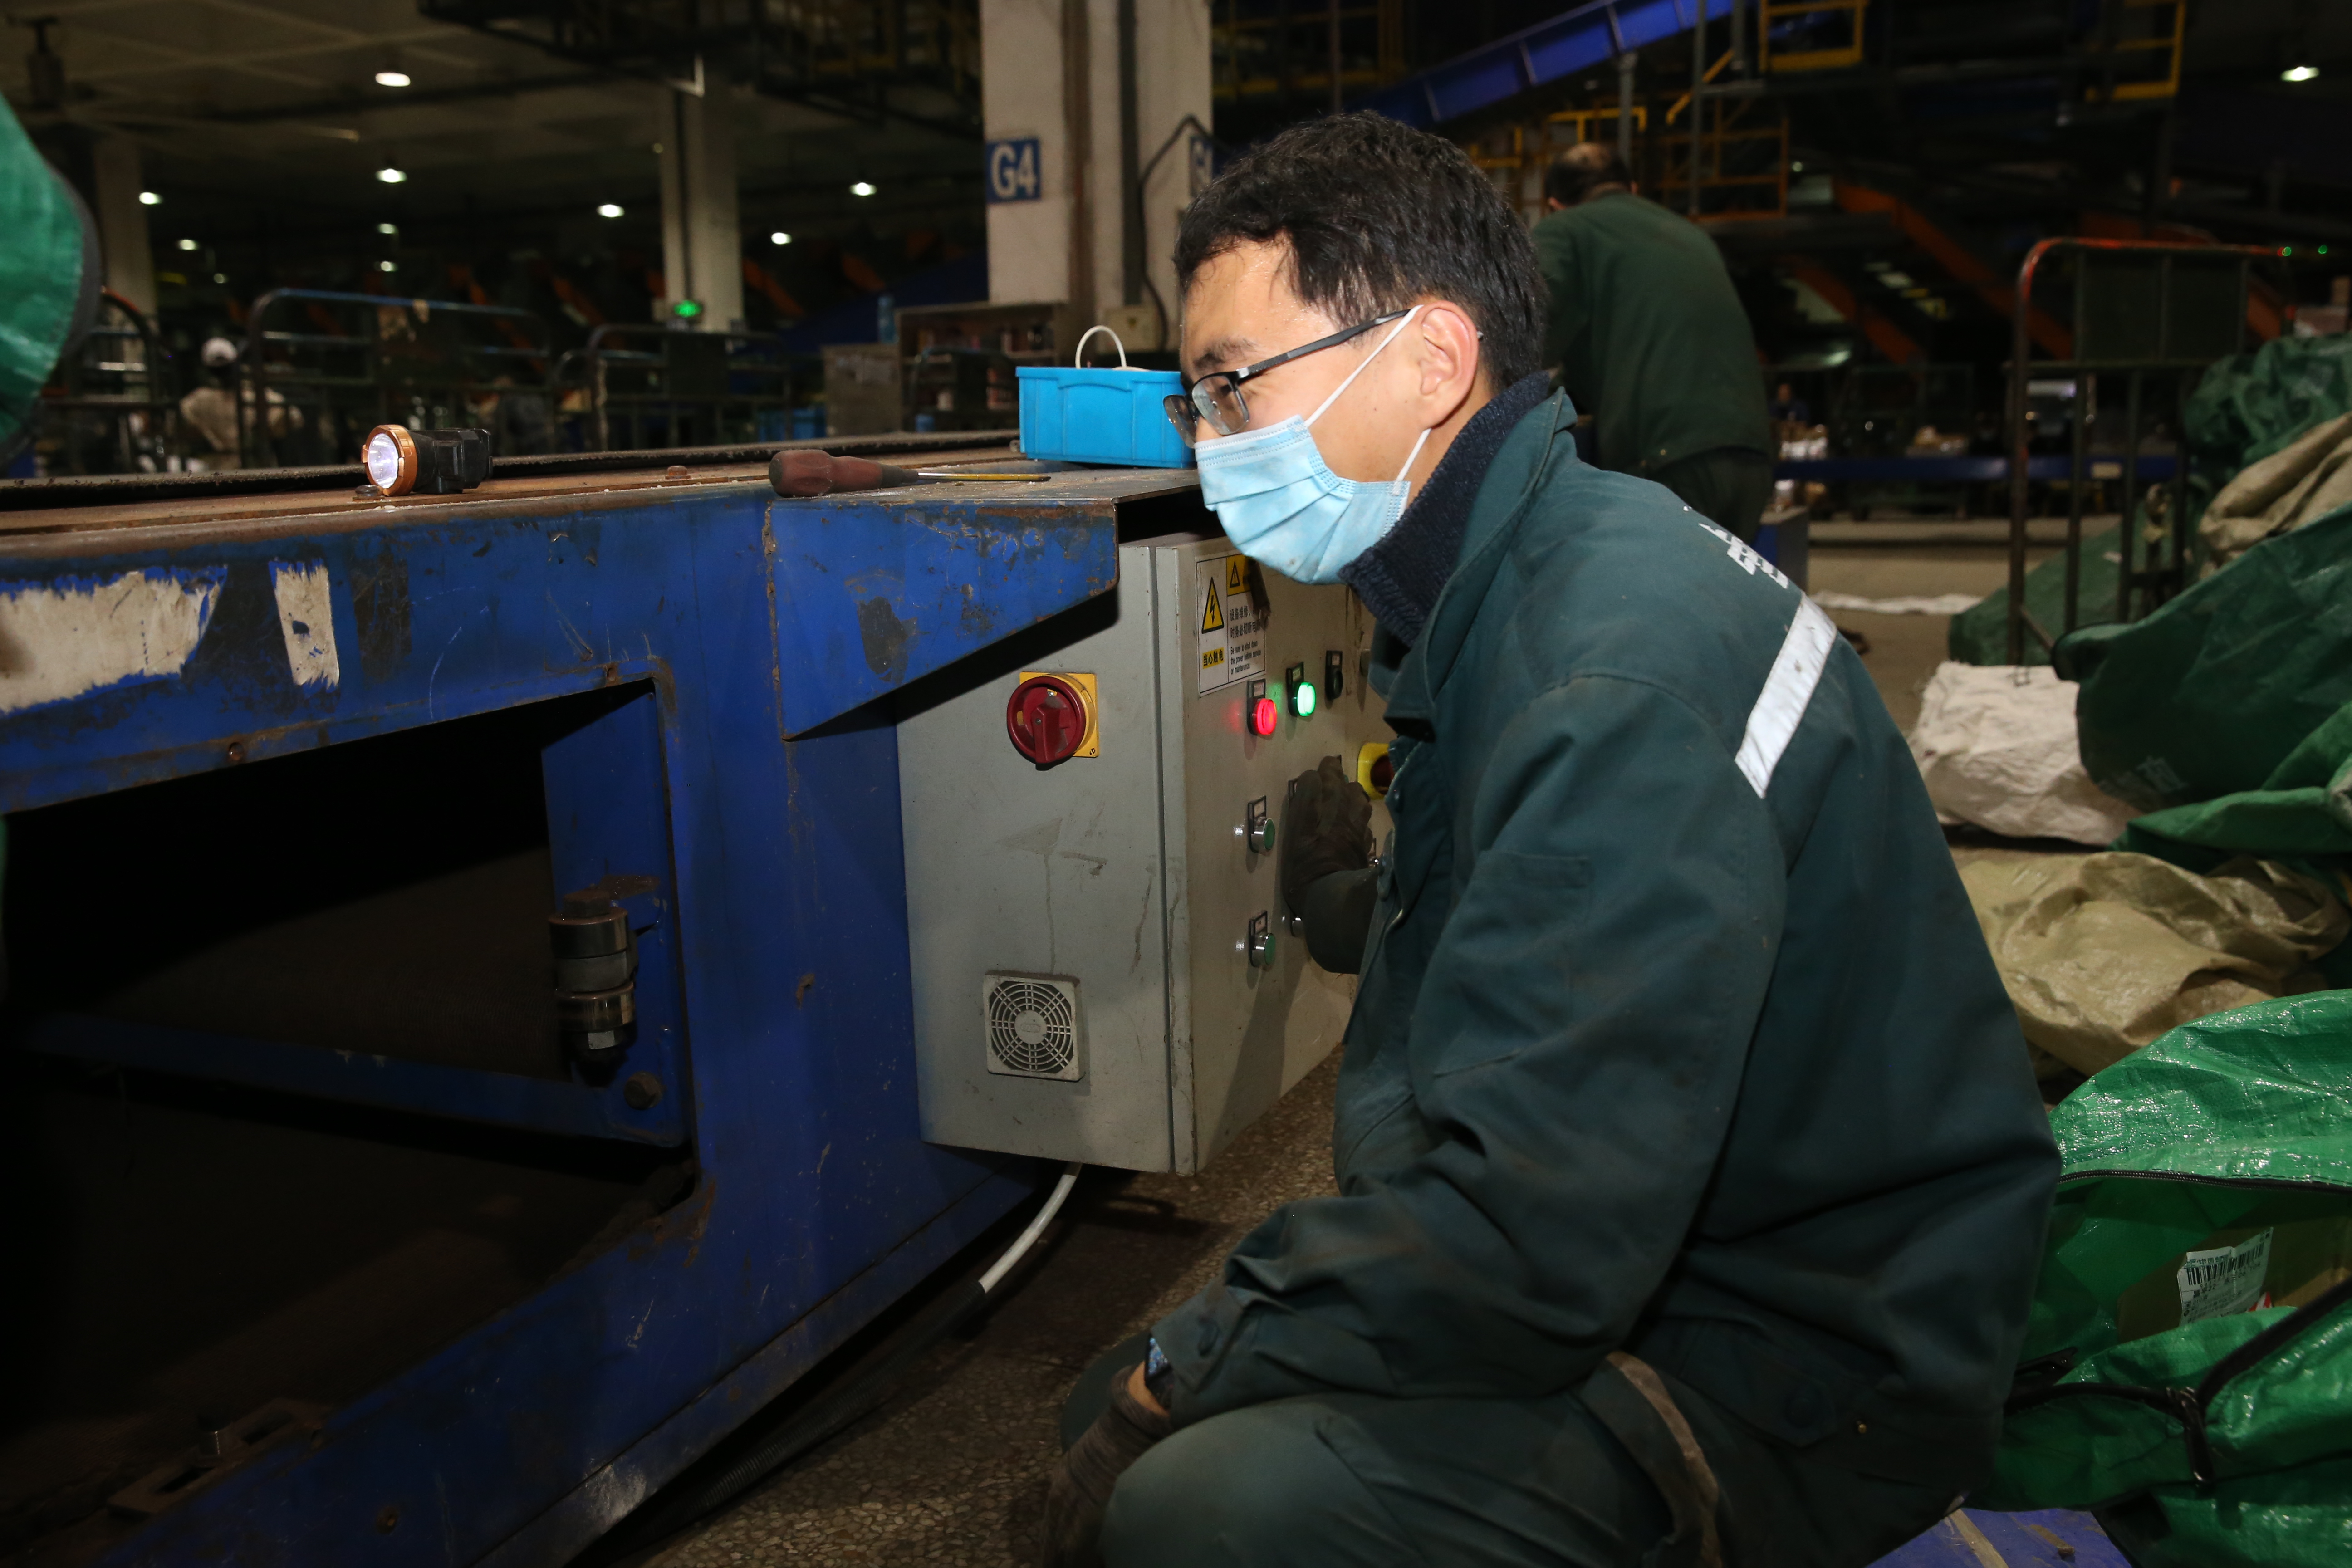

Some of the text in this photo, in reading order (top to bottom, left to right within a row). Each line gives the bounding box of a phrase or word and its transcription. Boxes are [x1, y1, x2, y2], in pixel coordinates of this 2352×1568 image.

[990, 143, 1037, 198] G4
[1204, 649, 1223, 666] 当心触电
[1230, 647, 1235, 655] Be
[1235, 655, 1244, 665] power
[1244, 652, 1252, 661] before
[1253, 648, 1261, 657] service
